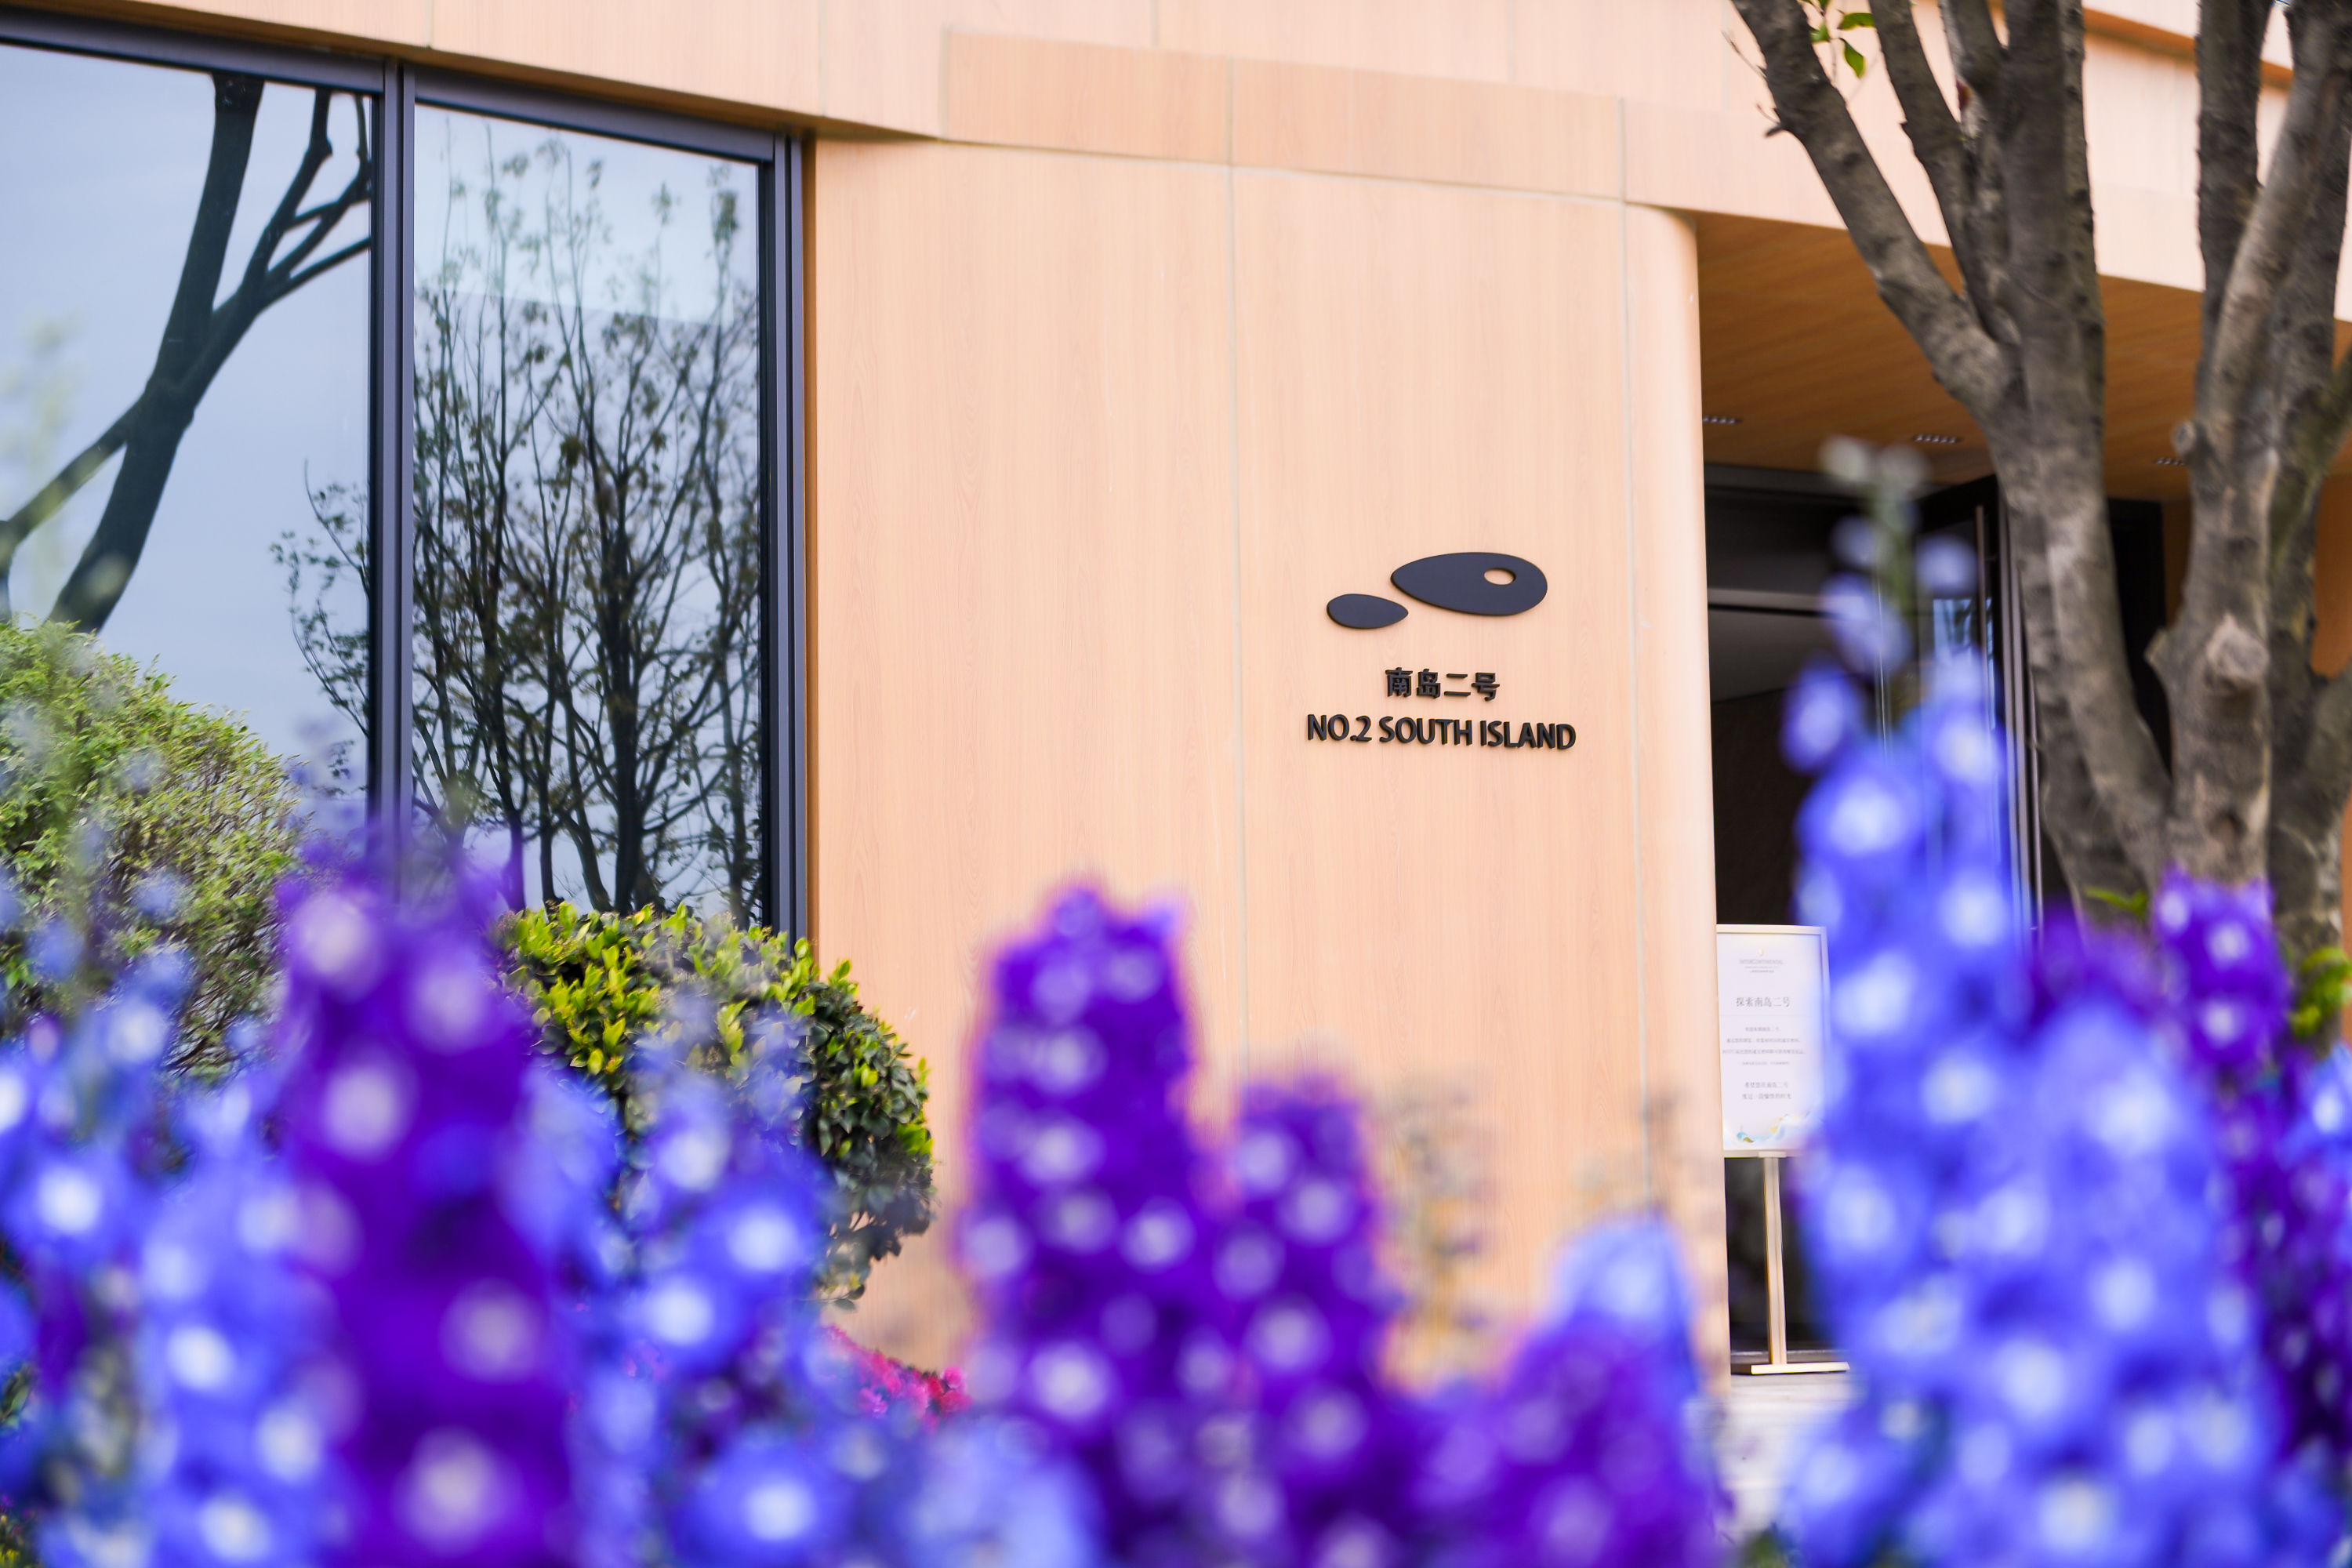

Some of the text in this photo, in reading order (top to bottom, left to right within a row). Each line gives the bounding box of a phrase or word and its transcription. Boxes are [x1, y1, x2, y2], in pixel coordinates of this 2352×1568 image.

[1385, 667, 1500, 701] 南岛二号
[1307, 714, 1577, 750] NO.2 SOUTH ISLAND
